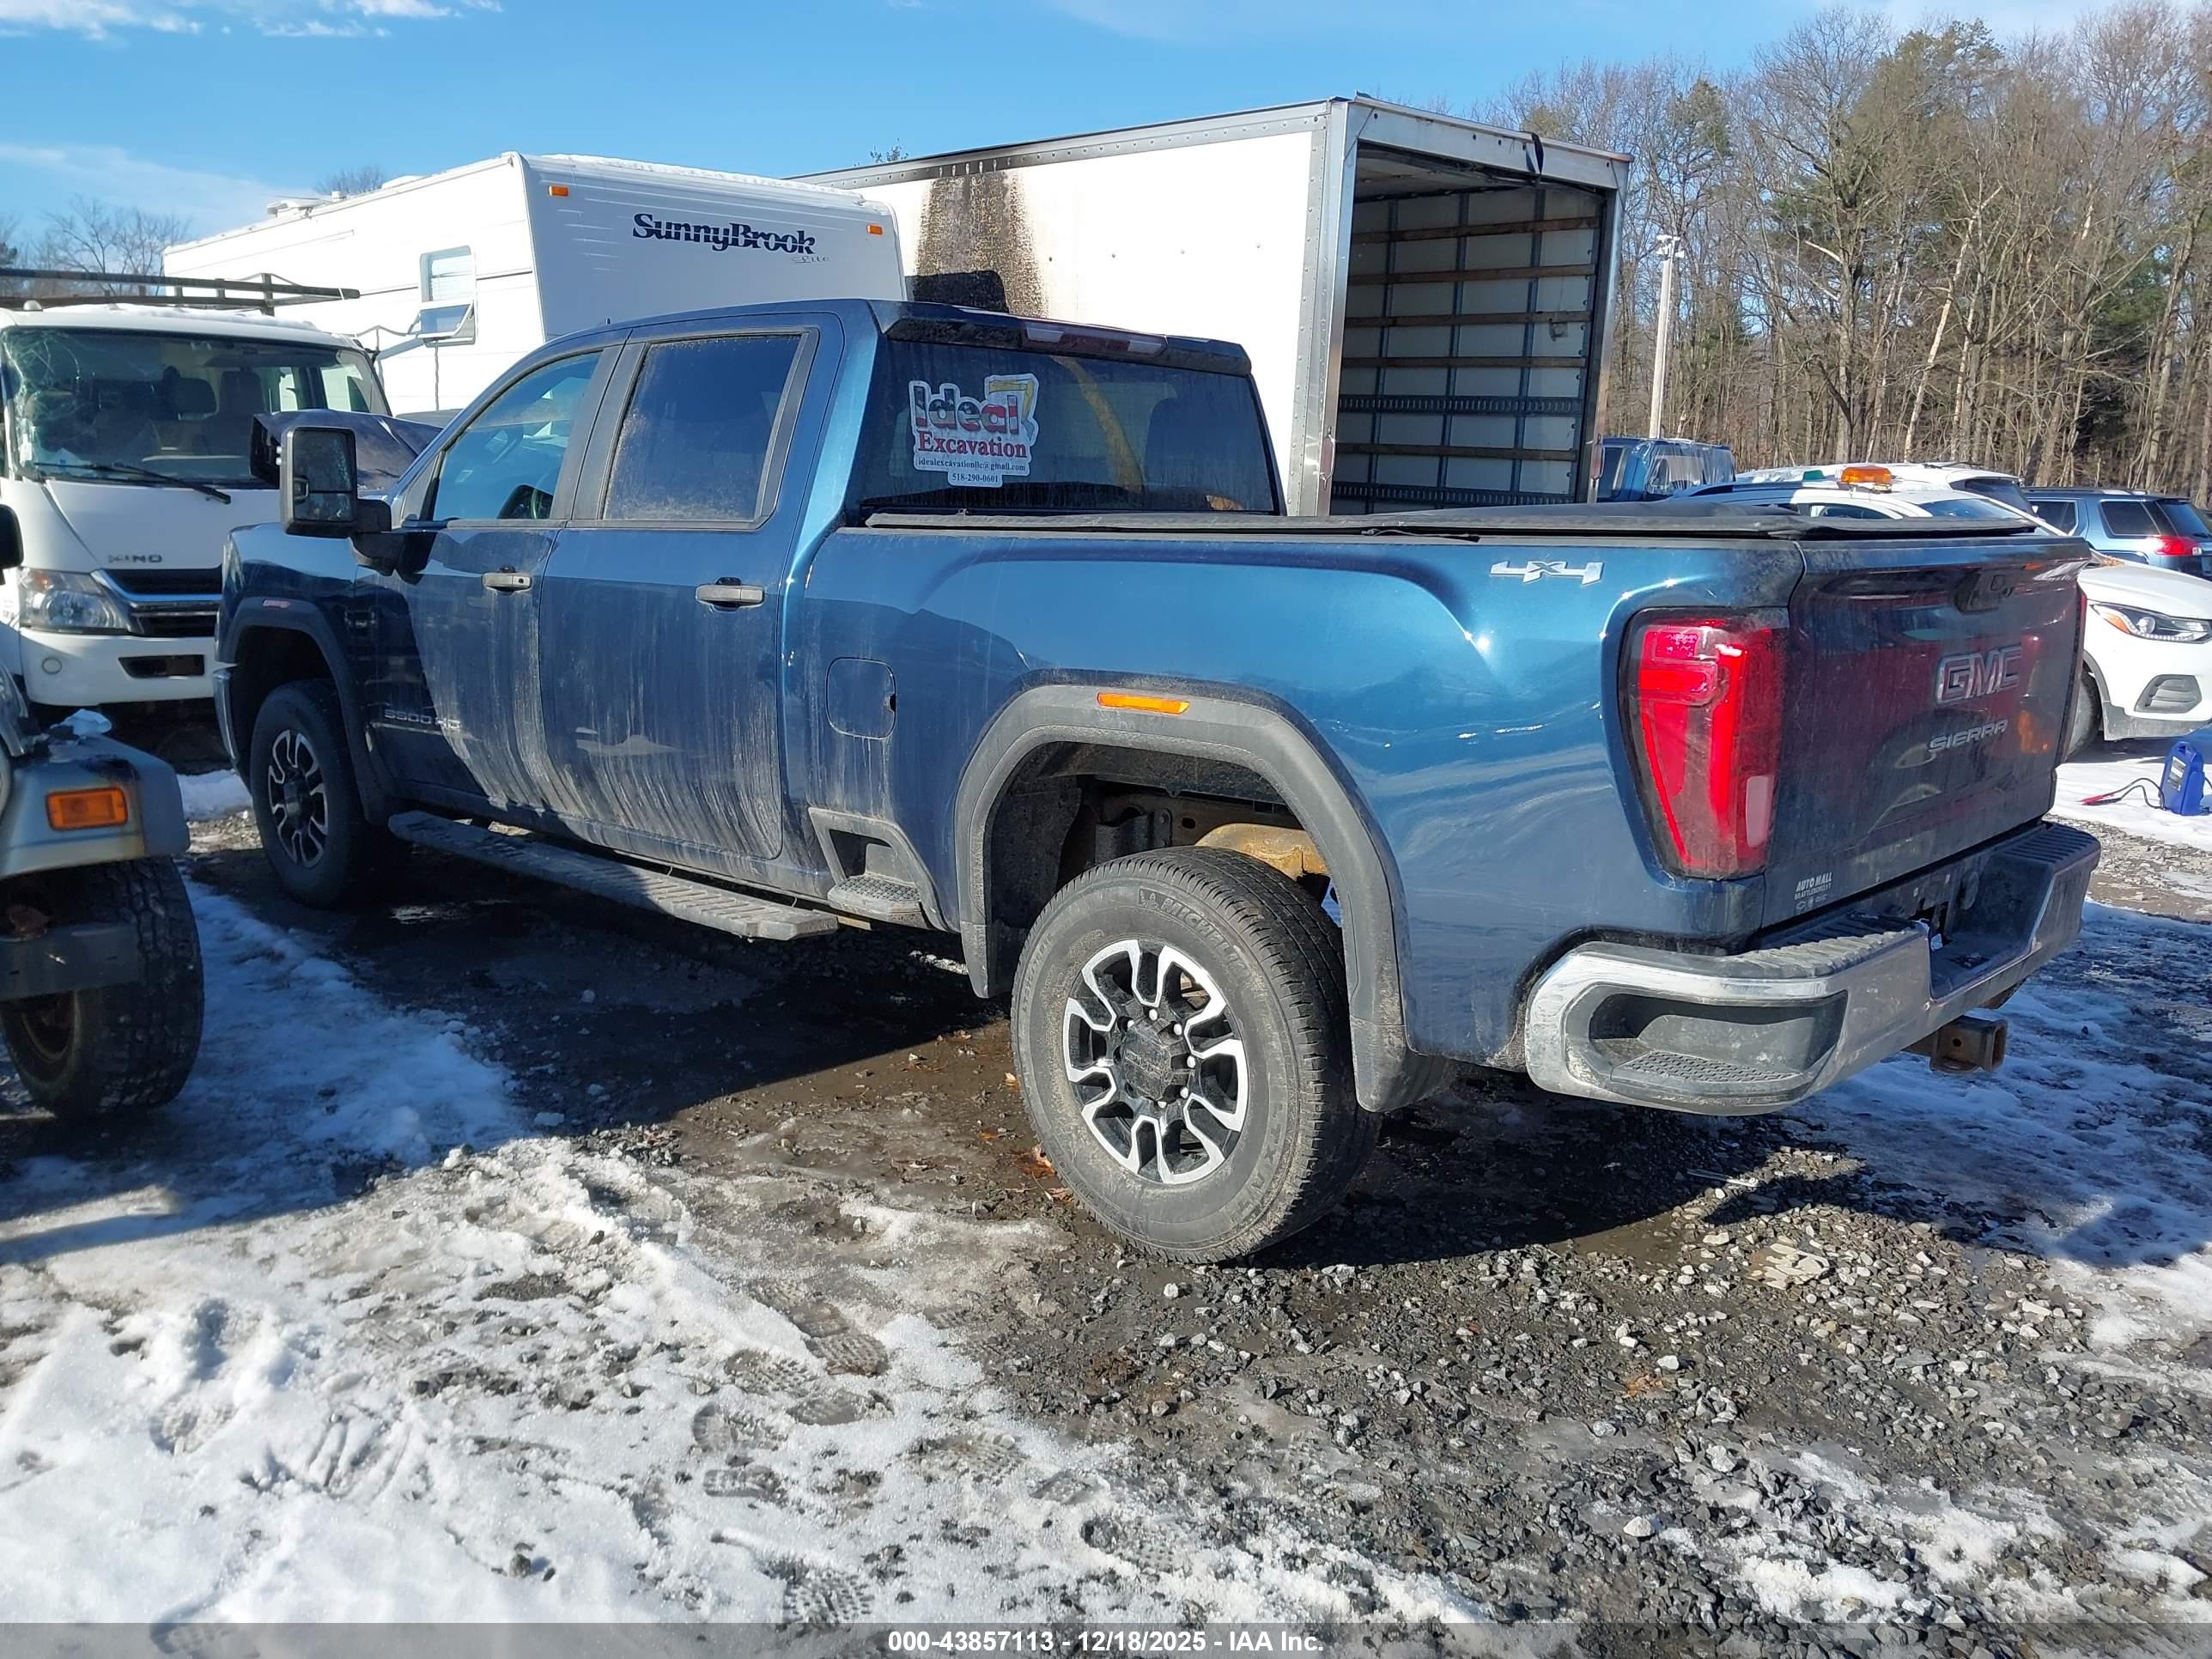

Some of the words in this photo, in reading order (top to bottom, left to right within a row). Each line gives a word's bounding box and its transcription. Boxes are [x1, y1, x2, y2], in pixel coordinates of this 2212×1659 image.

[632, 213, 816, 255] SunnyBrook
[914, 386, 1019, 434] Ideal
[918, 430, 1028, 458] Excavation
[951, 473, 999, 483] 518-290-0601
[1936, 643, 2021, 706] GMC
[1928, 719, 2008, 754] SIERRA
[1796, 878, 1815, 893] AUTO
[1815, 872, 1832, 886] MALL
